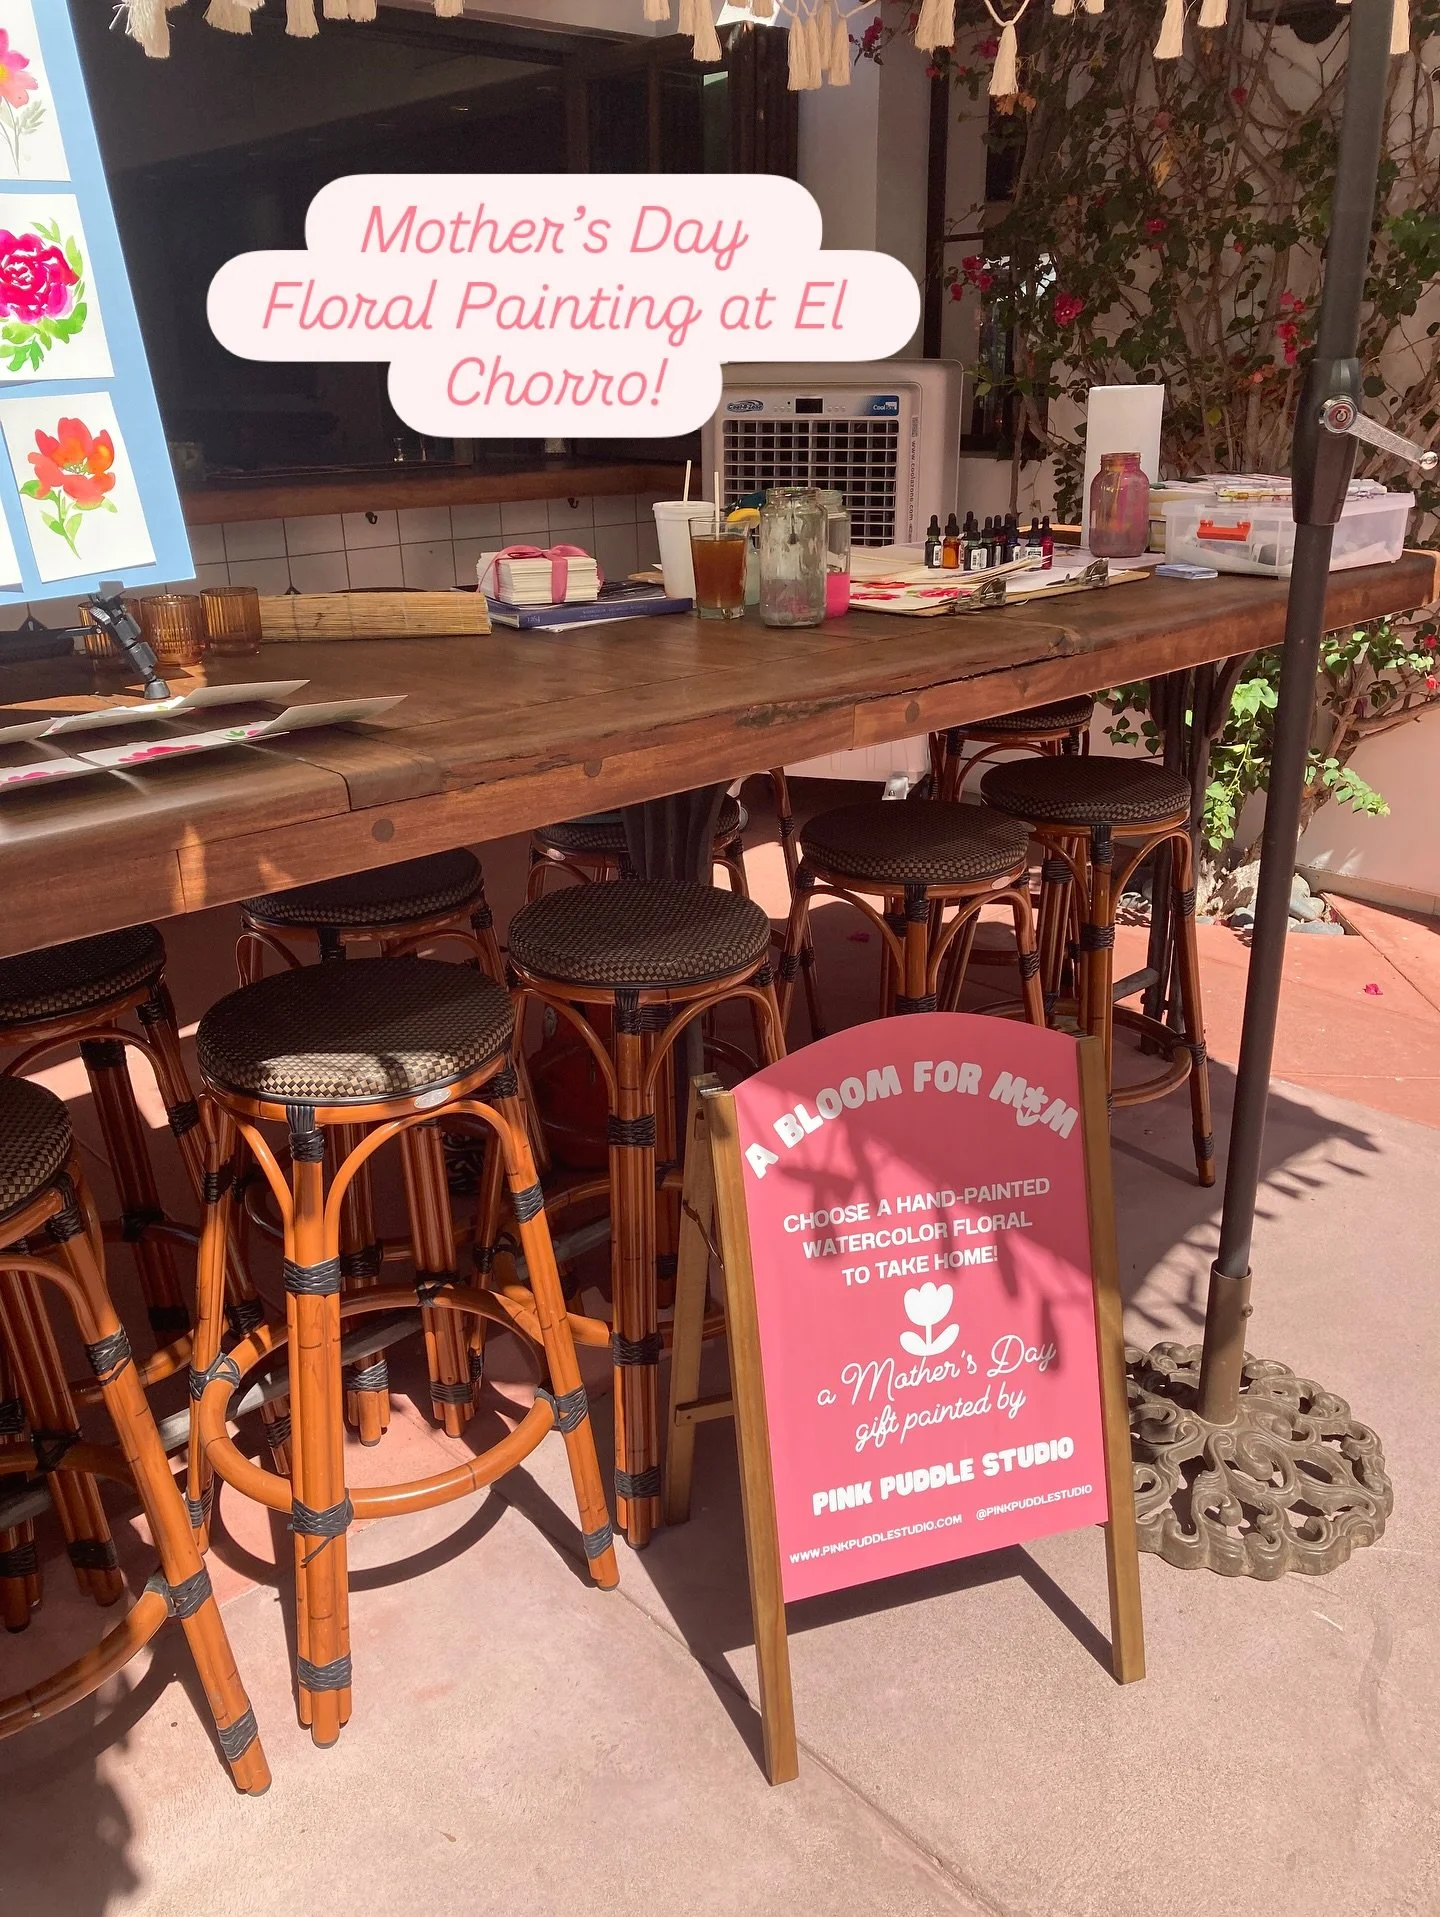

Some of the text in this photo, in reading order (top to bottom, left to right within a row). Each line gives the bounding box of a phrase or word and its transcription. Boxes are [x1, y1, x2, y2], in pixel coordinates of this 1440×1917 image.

[744, 1142, 780, 1180] A
[773, 1065, 902, 1149] BLOOM
[913, 1060, 983, 1096] FOR
[783, 1177, 1051, 1234] CHOOSE A HAND-PAINTED
[803, 1211, 1033, 1260] WATERCOLOR FLORAL
[841, 1245, 999, 1287] TO TAKE HOME!
[816, 1334, 1057, 1406] a Mother's Day
[855, 1381, 1027, 1453] gift painted by
[812, 1436, 1075, 1517] PINK PUDDLE STUDIO
[789, 1484, 1093, 1564] WWW.PINKPUDDLESTUDIO.COM @PINKPUDDLESTUDIO
